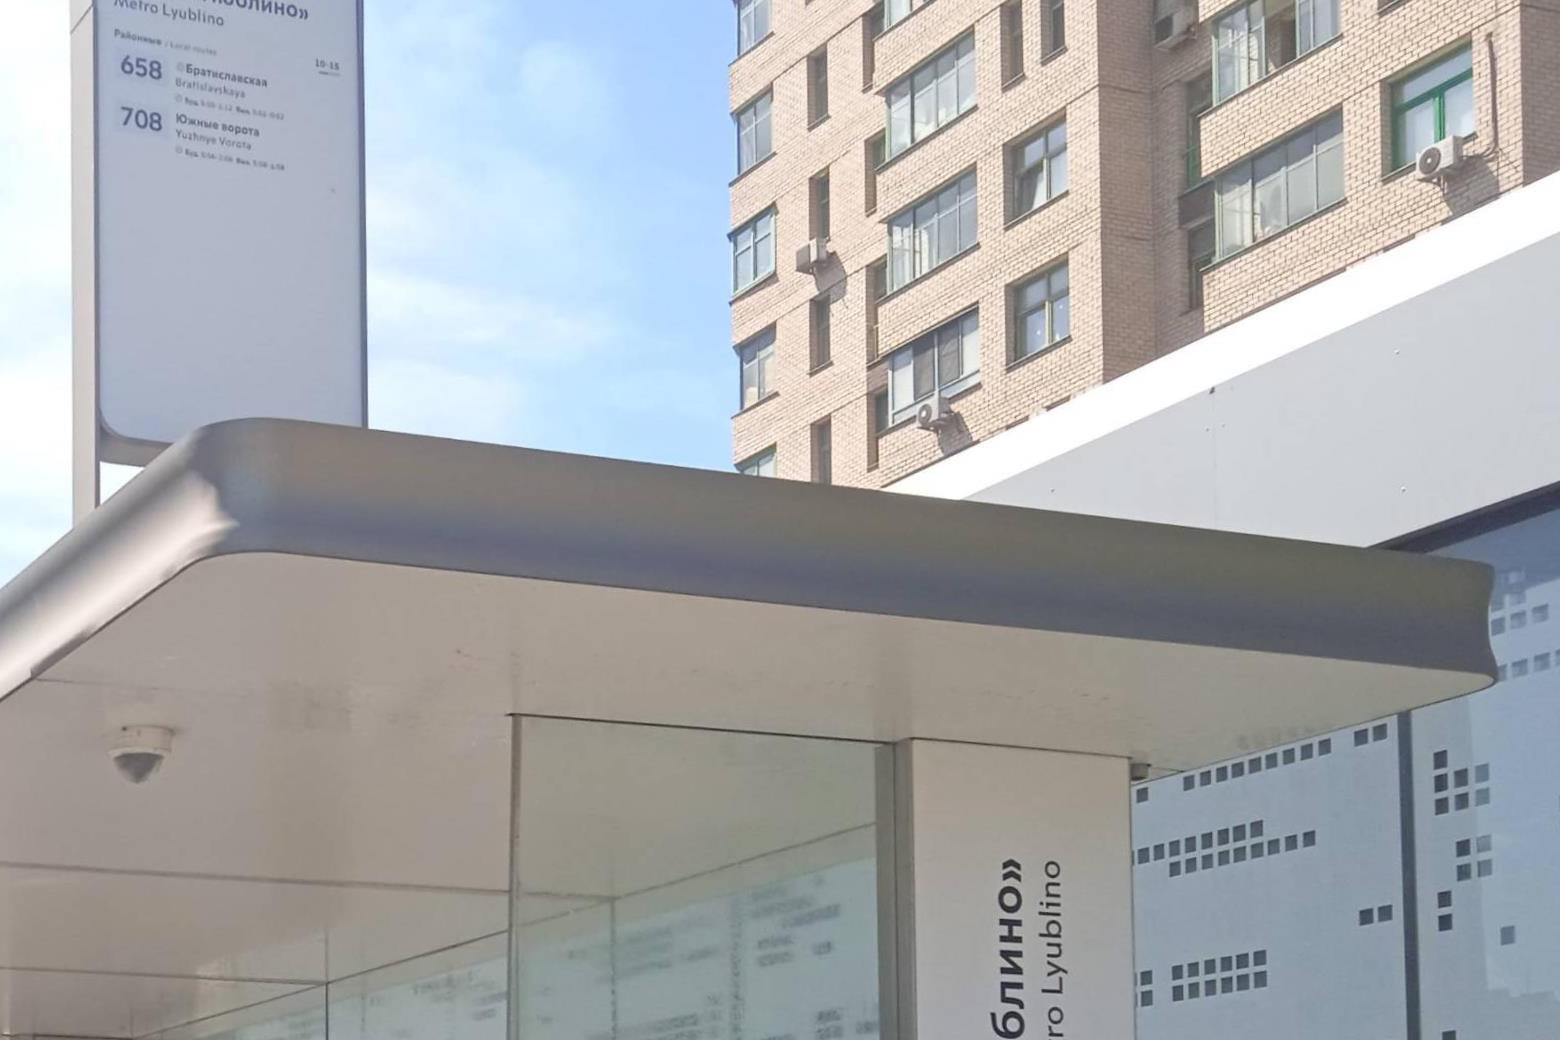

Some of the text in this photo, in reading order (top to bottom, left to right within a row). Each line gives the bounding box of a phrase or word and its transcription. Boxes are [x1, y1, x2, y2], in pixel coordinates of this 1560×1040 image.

[162, 3, 225, 27] Lyublino
[120, 54, 163, 81] 658
[186, 63, 268, 88] Братиславская
[120, 106, 163, 132] 708
[176, 113, 260, 137] Южные ворота
[175, 128, 217, 146] Yuzhnye
[1038, 860, 1068, 995] Lyublino
